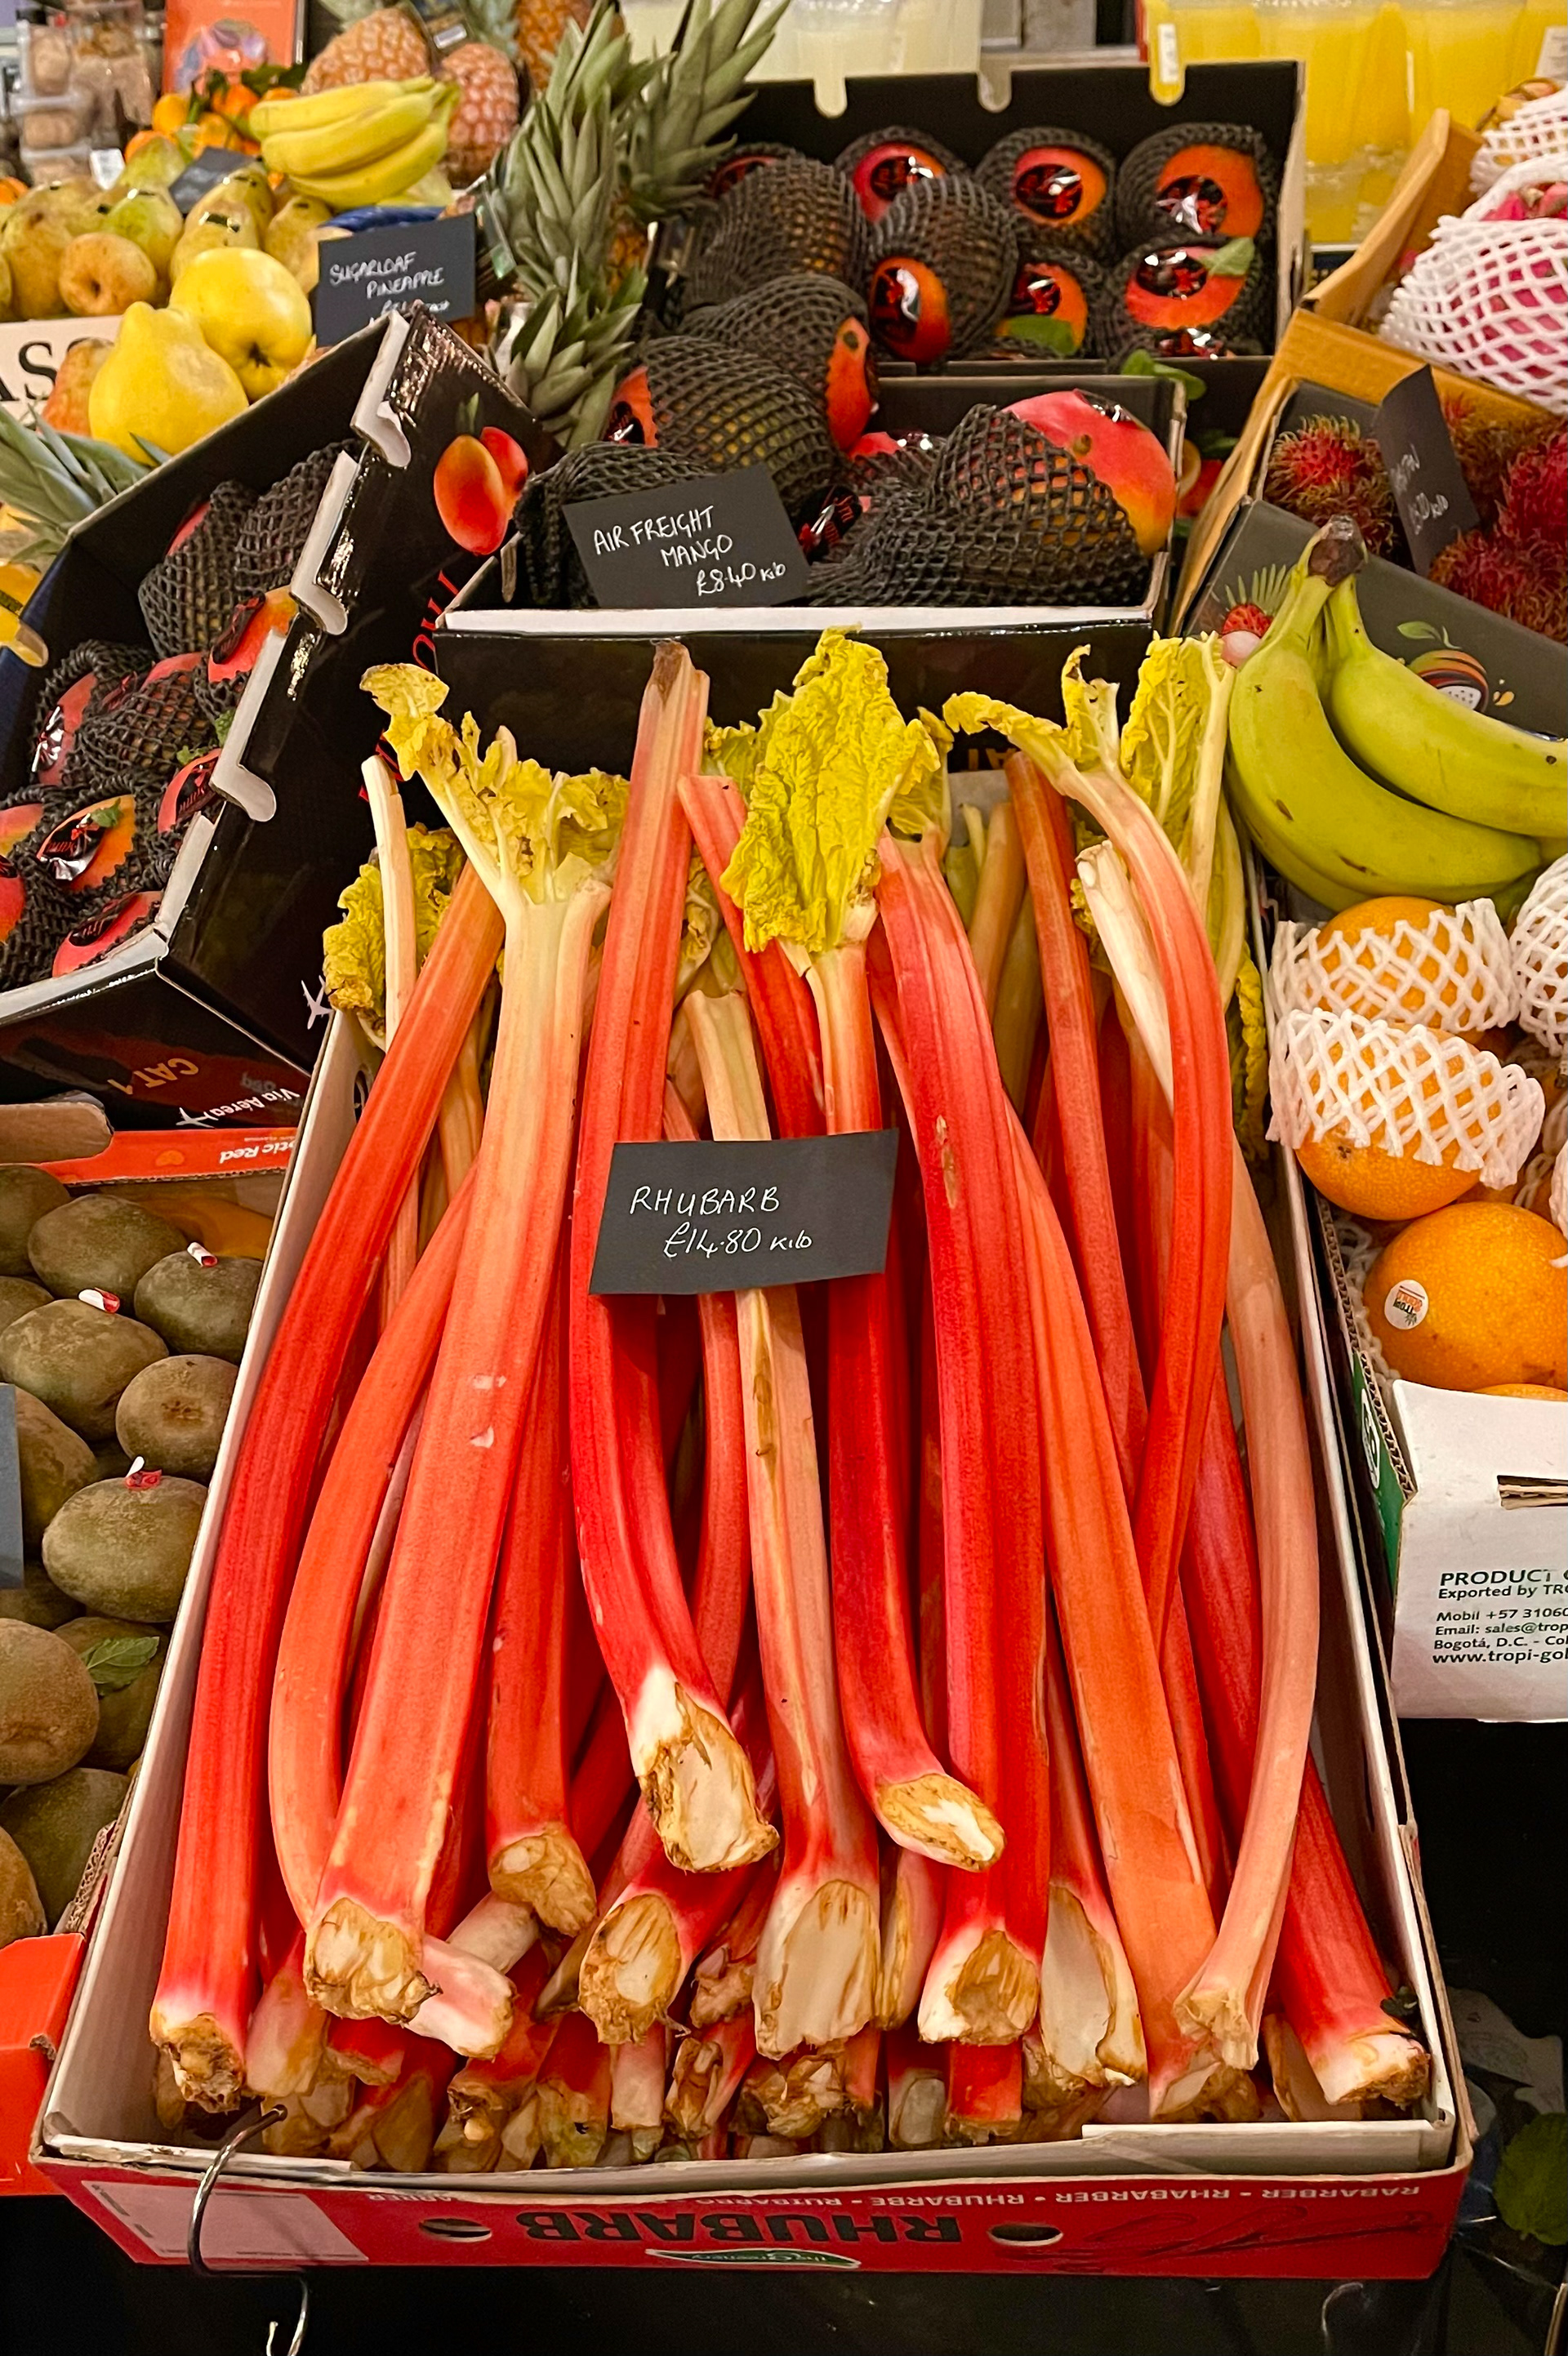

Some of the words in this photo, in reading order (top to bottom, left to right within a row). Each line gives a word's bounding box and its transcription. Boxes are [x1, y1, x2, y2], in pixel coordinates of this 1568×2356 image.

[329, 251, 416, 286] SUGARLOAF
[594, 525, 630, 555] AIR
[630, 505, 715, 545] FREIGHT
[660, 533, 733, 568] MANGO
[133, 1058, 199, 1089] CAT
[107, 1079, 134, 1095] 1
[208, 1095, 265, 1117] Aérea
[219, 1145, 259, 1164] Red
[630, 1185, 781, 1216] RHUBARB
[1440, 1569, 1554, 1586] PRODUCT
[1438, 1585, 1512, 1601] Exported
[1517, 1584, 1538, 1598] by
[1543, 1584, 1567, 1595] TR
[1436, 1610, 1480, 1622] Mobil
[1486, 1609, 1518, 1619] +57
[1435, 1624, 1480, 1636] Email:
[1434, 1637, 1490, 1651] Bogotá,
[1496, 1637, 1528, 1647] D.C.
[871, 2193, 1024, 2207] RHUBARBE
[1055, 2188, 1230, 2203] RHABARBER
[1262, 2185, 1419, 2199] RABARBER
[515, 2211, 962, 2243] RHUBARB
